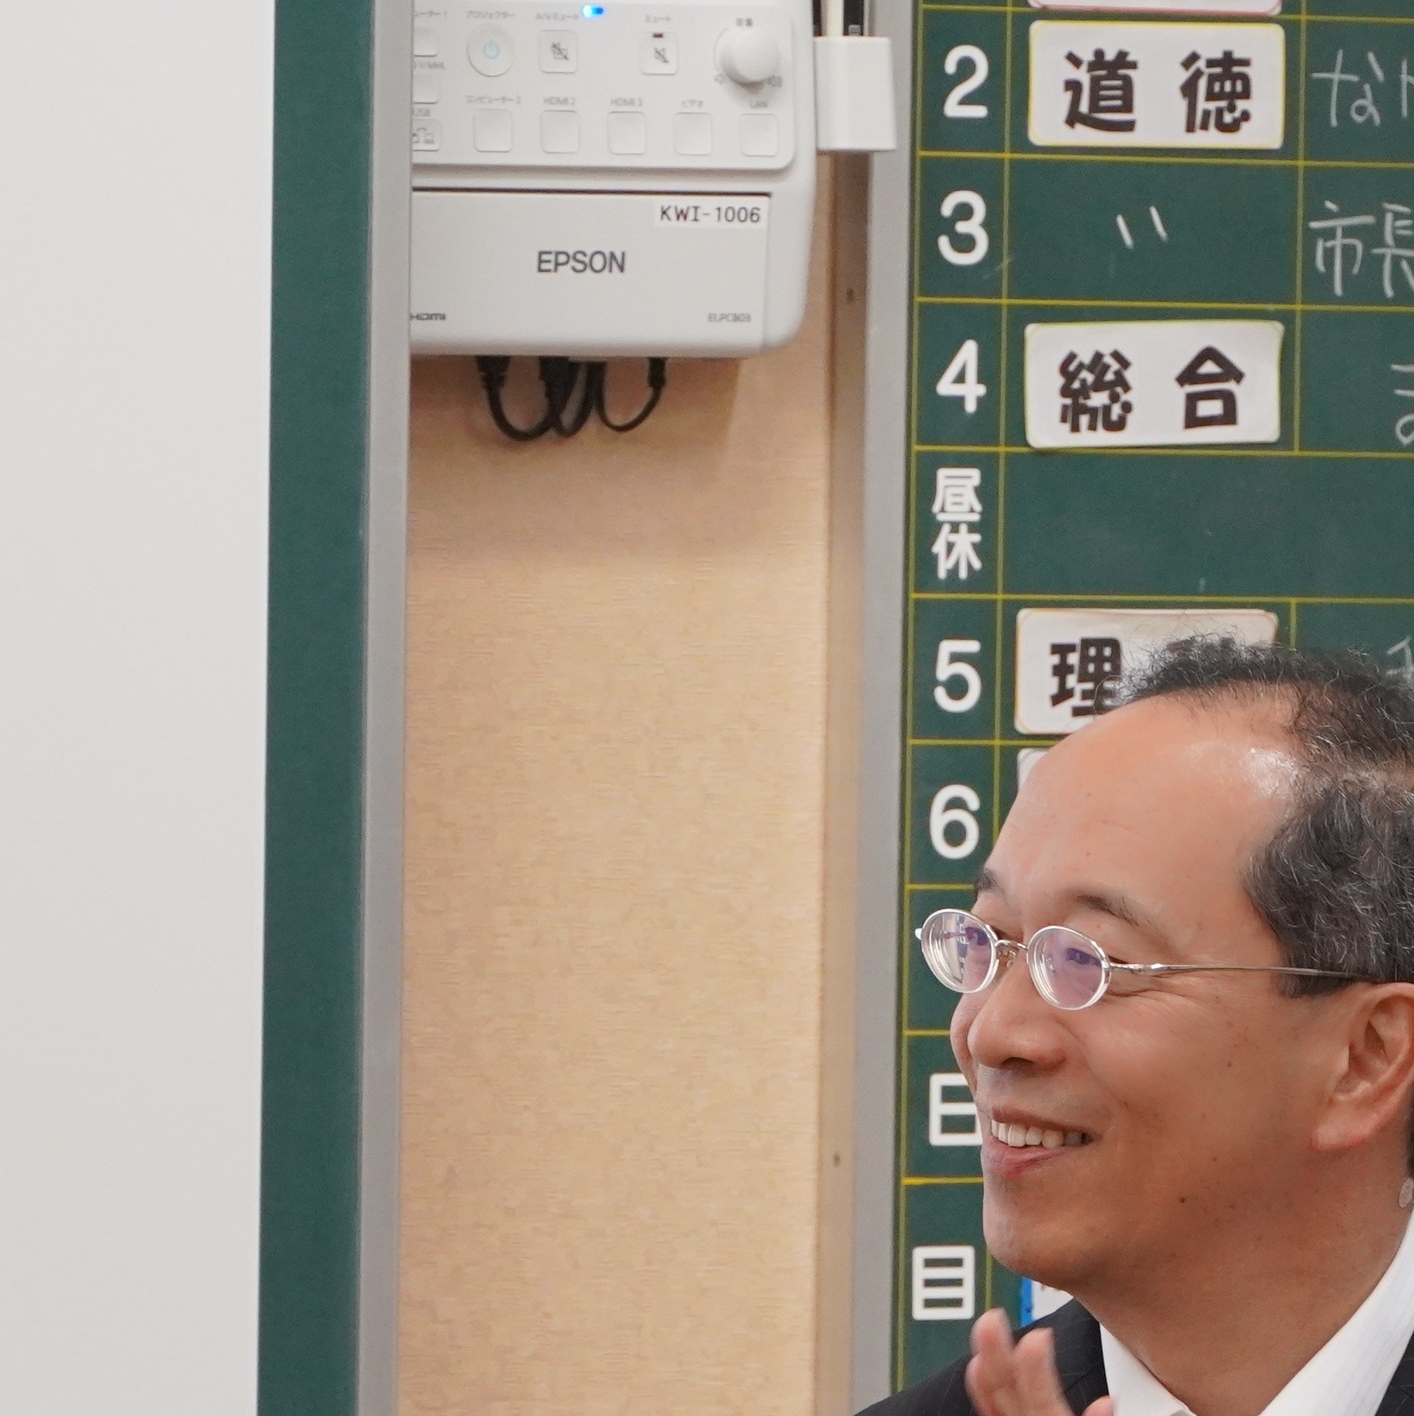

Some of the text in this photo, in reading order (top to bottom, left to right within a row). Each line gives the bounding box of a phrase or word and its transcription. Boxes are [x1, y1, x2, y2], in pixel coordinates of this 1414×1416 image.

[944, 45, 988, 117] 2
[1065, 49, 1251, 133] 道徳
[661, 206, 760, 222] KWI-1006
[939, 191, 988, 264] 3
[538, 251, 625, 273] EPSON
[937, 340, 986, 413] 4
[1060, 346, 1244, 433] 総合
[932, 468, 981, 579] 昼休
[935, 640, 980, 712] 5
[930, 785, 979, 858] 6
[915, 1248, 972, 1318] 目
